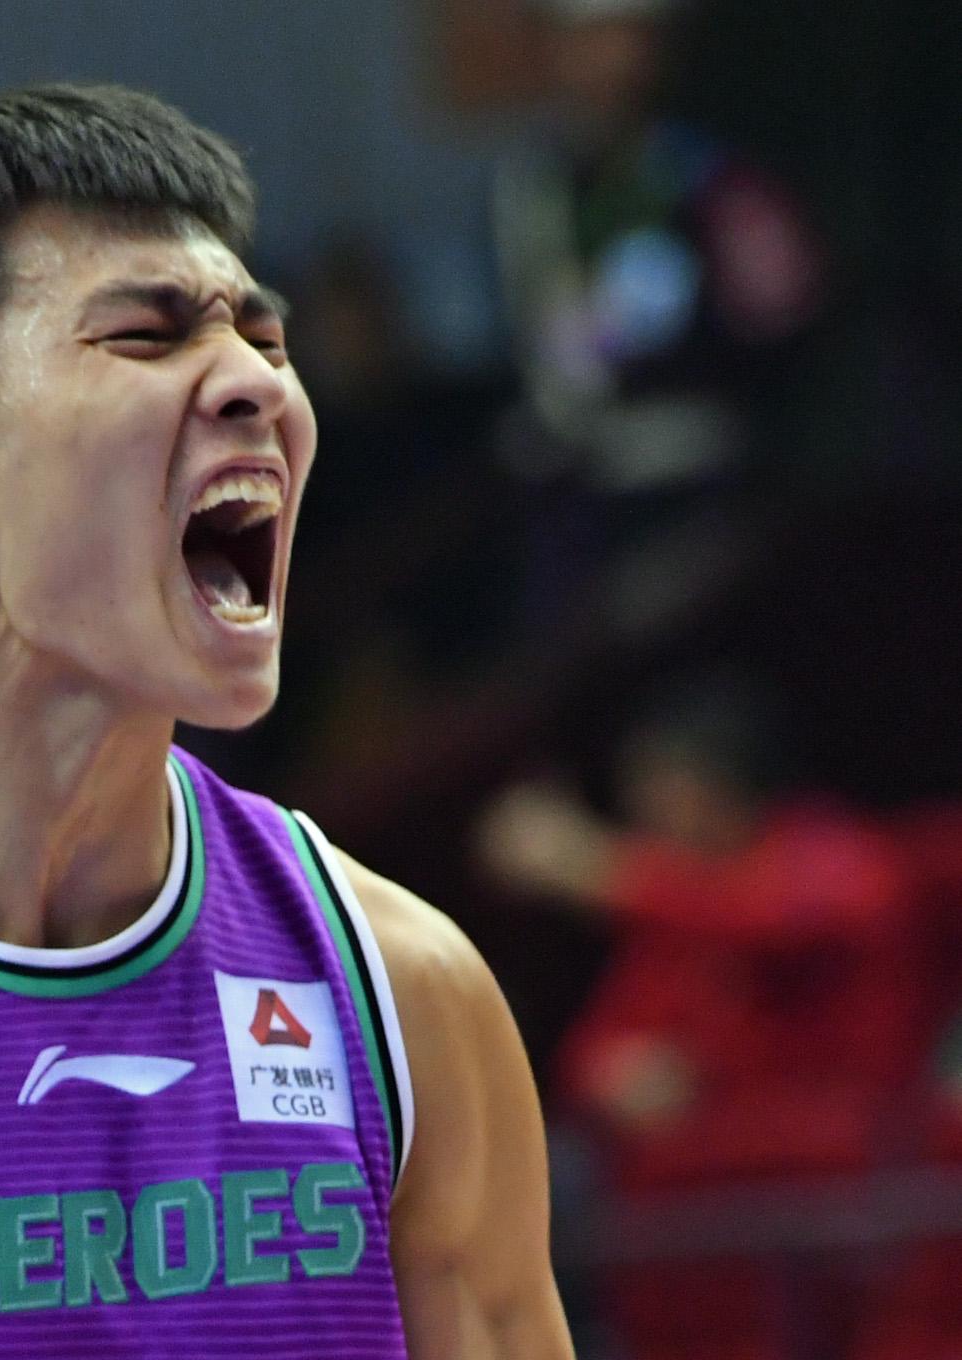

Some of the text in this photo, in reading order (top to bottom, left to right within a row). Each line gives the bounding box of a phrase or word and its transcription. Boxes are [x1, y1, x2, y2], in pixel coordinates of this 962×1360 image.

[250, 1065, 335, 1091] 广发银行
[272, 1094, 327, 1117] CGB
